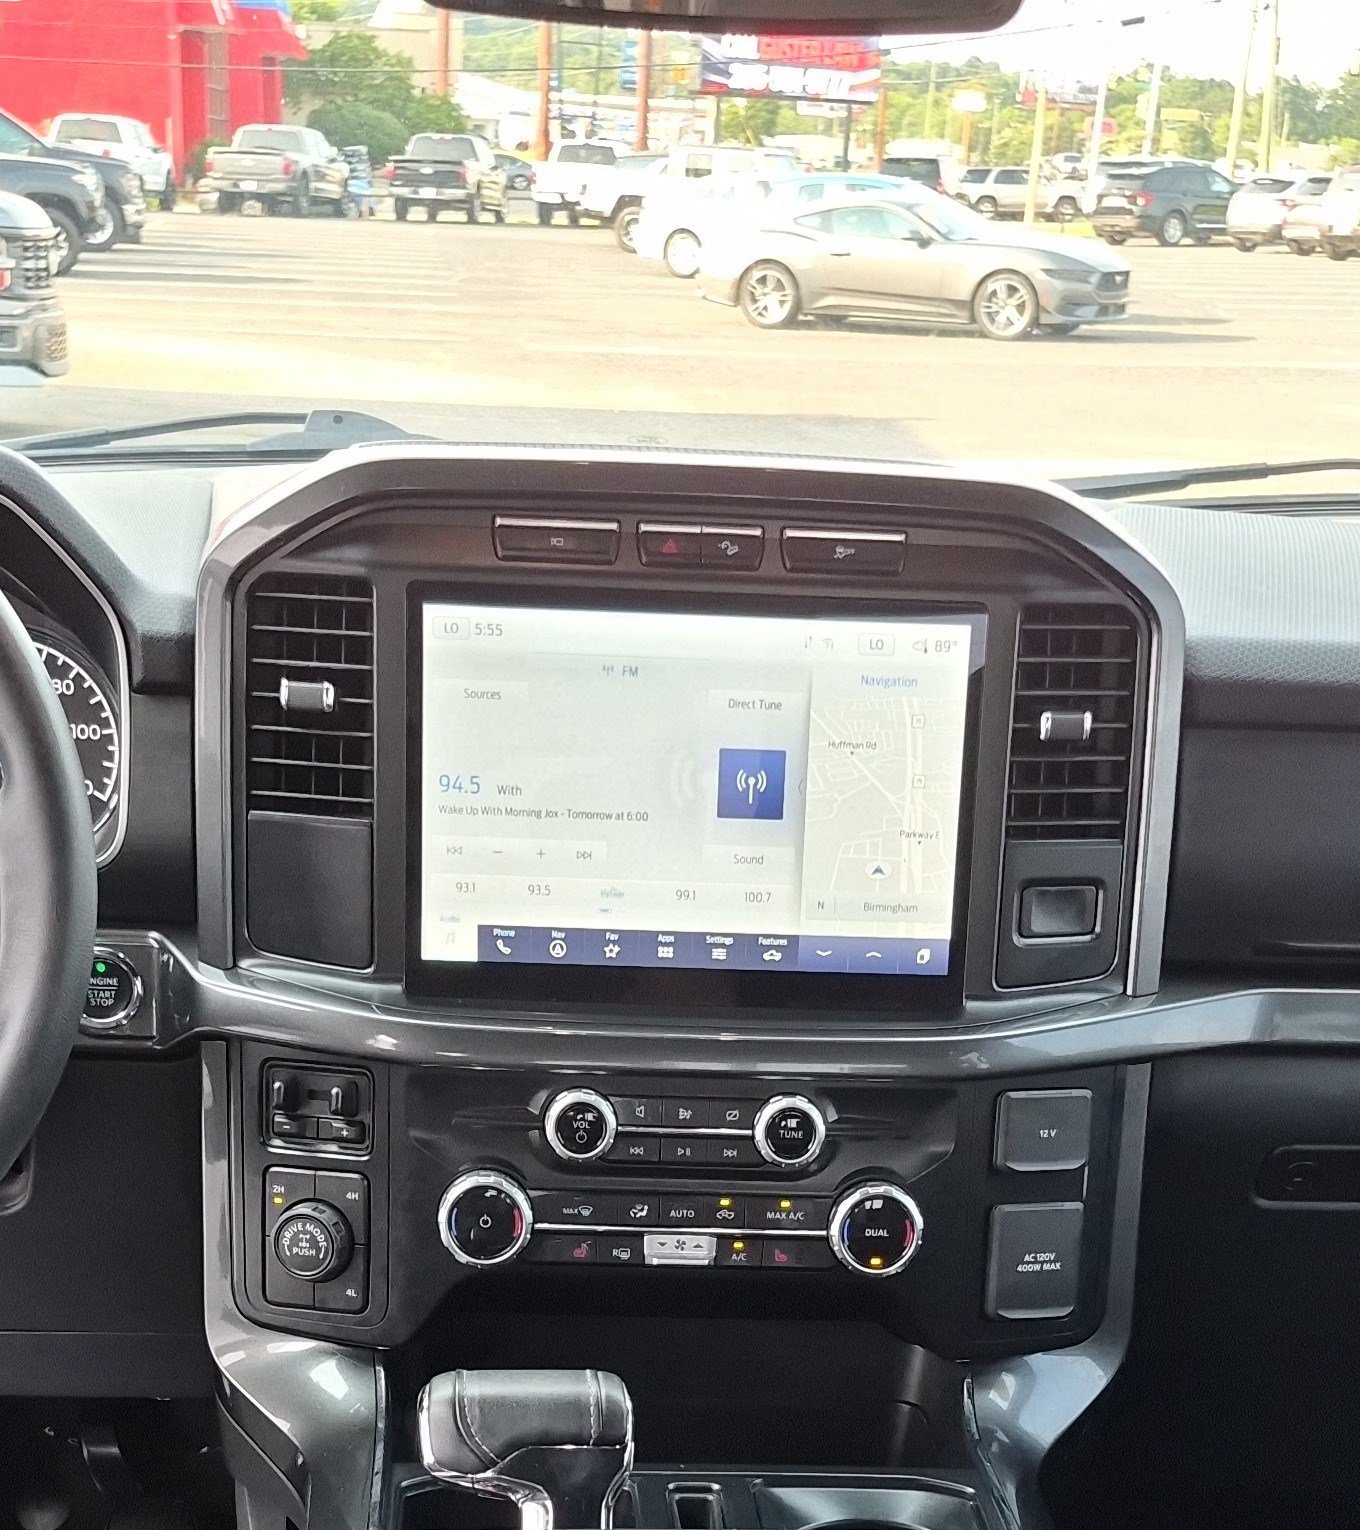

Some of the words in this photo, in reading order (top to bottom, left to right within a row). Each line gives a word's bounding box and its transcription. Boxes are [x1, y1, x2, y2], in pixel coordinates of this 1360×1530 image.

[474, 623, 503, 637] 5:55
[869, 639, 884, 650] LO
[622, 666, 639, 677] FM
[860, 675, 918, 688] Navigation
[464, 688, 502, 701] Sources
[728, 698, 756, 710] Direct
[759, 699, 782, 711] Tune
[70, 723, 101, 740] 100
[866, 741, 877, 750] Rd
[439, 774, 481, 795] 94.5
[497, 784, 522, 797] With
[438, 804, 464, 816] Wake
[465, 805, 479, 817] Up
[481, 806, 503, 817] With
[504, 807, 542, 820] Morning
[544, 809, 559, 820] Jox
[567, 809, 613, 821] Tomorrow
[615, 812, 624, 821] at
[626, 812, 649, 822] 6:00
[899, 830, 933, 840] Parkway
[733, 854, 764, 865] Sound
[455, 882, 476, 893] 93.1
[528, 884, 551, 896] 93.5
[675, 889, 696, 901] 99.1
[745, 891, 771, 903] 100.7
[817, 901, 825, 910] N
[863, 902, 918, 914] Birmingham
[493, 928, 516, 938] Phone
[551, 930, 566, 939] Nav
[605, 932, 619, 941] Fav
[657, 934, 675, 944] Apps
[705, 935, 734, 945] Settings
[758, 937, 788, 946] Features
[89, 977, 119, 986] NGINE
[88, 990, 115, 998] START
[90, 998, 115, 1007] STOP
[572, 1120, 590, 1129] VOL
[779, 1130, 804, 1139] TUNE
[345, 1191, 359, 1200] 4H
[669, 1209, 695, 1218] AUTO
[766, 1211, 787, 1220] MAX
[789, 1211, 805, 1221] A/C
[282, 1222, 304, 1246] DRIVE
[305, 1222, 327, 1248] MODE
[864, 1228, 890, 1237] DUAL
[292, 1246, 316, 1257] PUSH
[731, 1253, 747, 1261] A/C
[1023, 1253, 1036, 1262] AC
[1036, 1252, 1056, 1261] 120V
[1017, 1262, 1042, 1272] 400W
[1043, 1262, 1061, 1271] MAX
[345, 1288, 358, 1297] 4L
